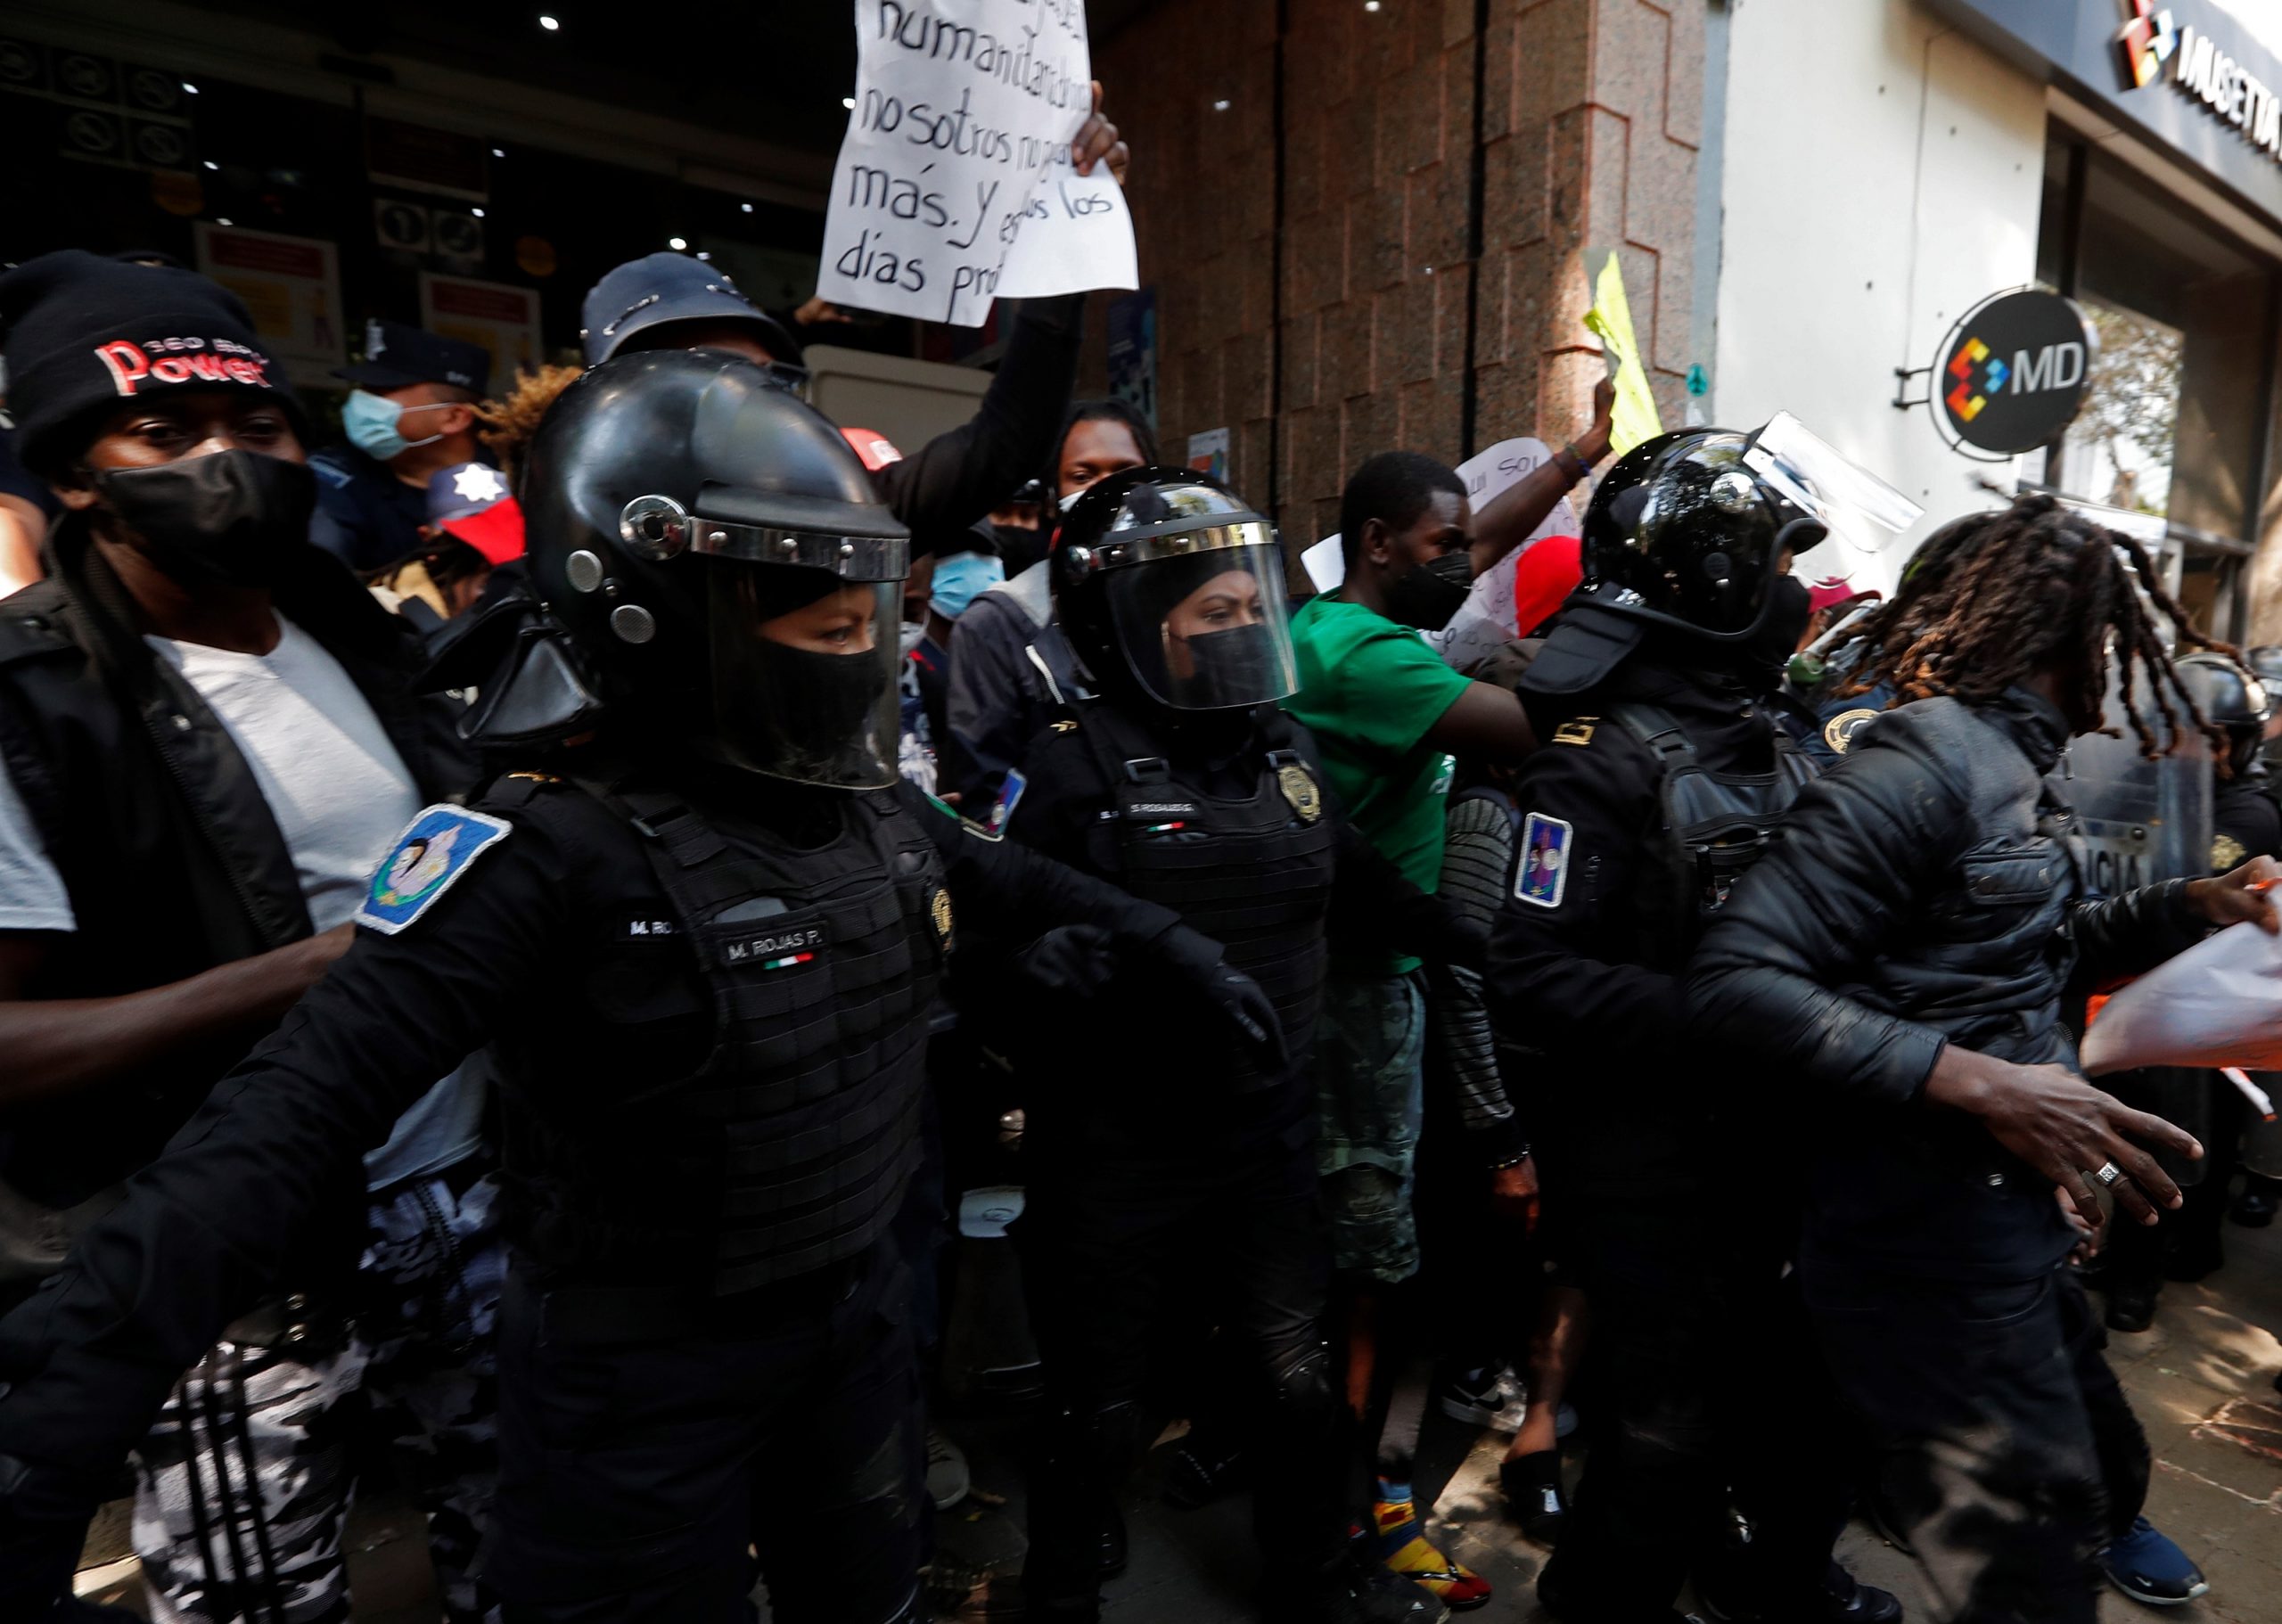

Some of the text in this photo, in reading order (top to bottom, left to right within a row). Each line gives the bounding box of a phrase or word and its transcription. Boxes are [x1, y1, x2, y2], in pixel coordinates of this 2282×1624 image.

[2177, 25, 2279, 153] MUSETTA
[860, 87, 1012, 163] nosotros
[1058, 180, 1112, 219] los
[836, 228, 926, 292] días
[2011, 341, 2083, 395] MD
[751, 933, 805, 956] ROJAS
